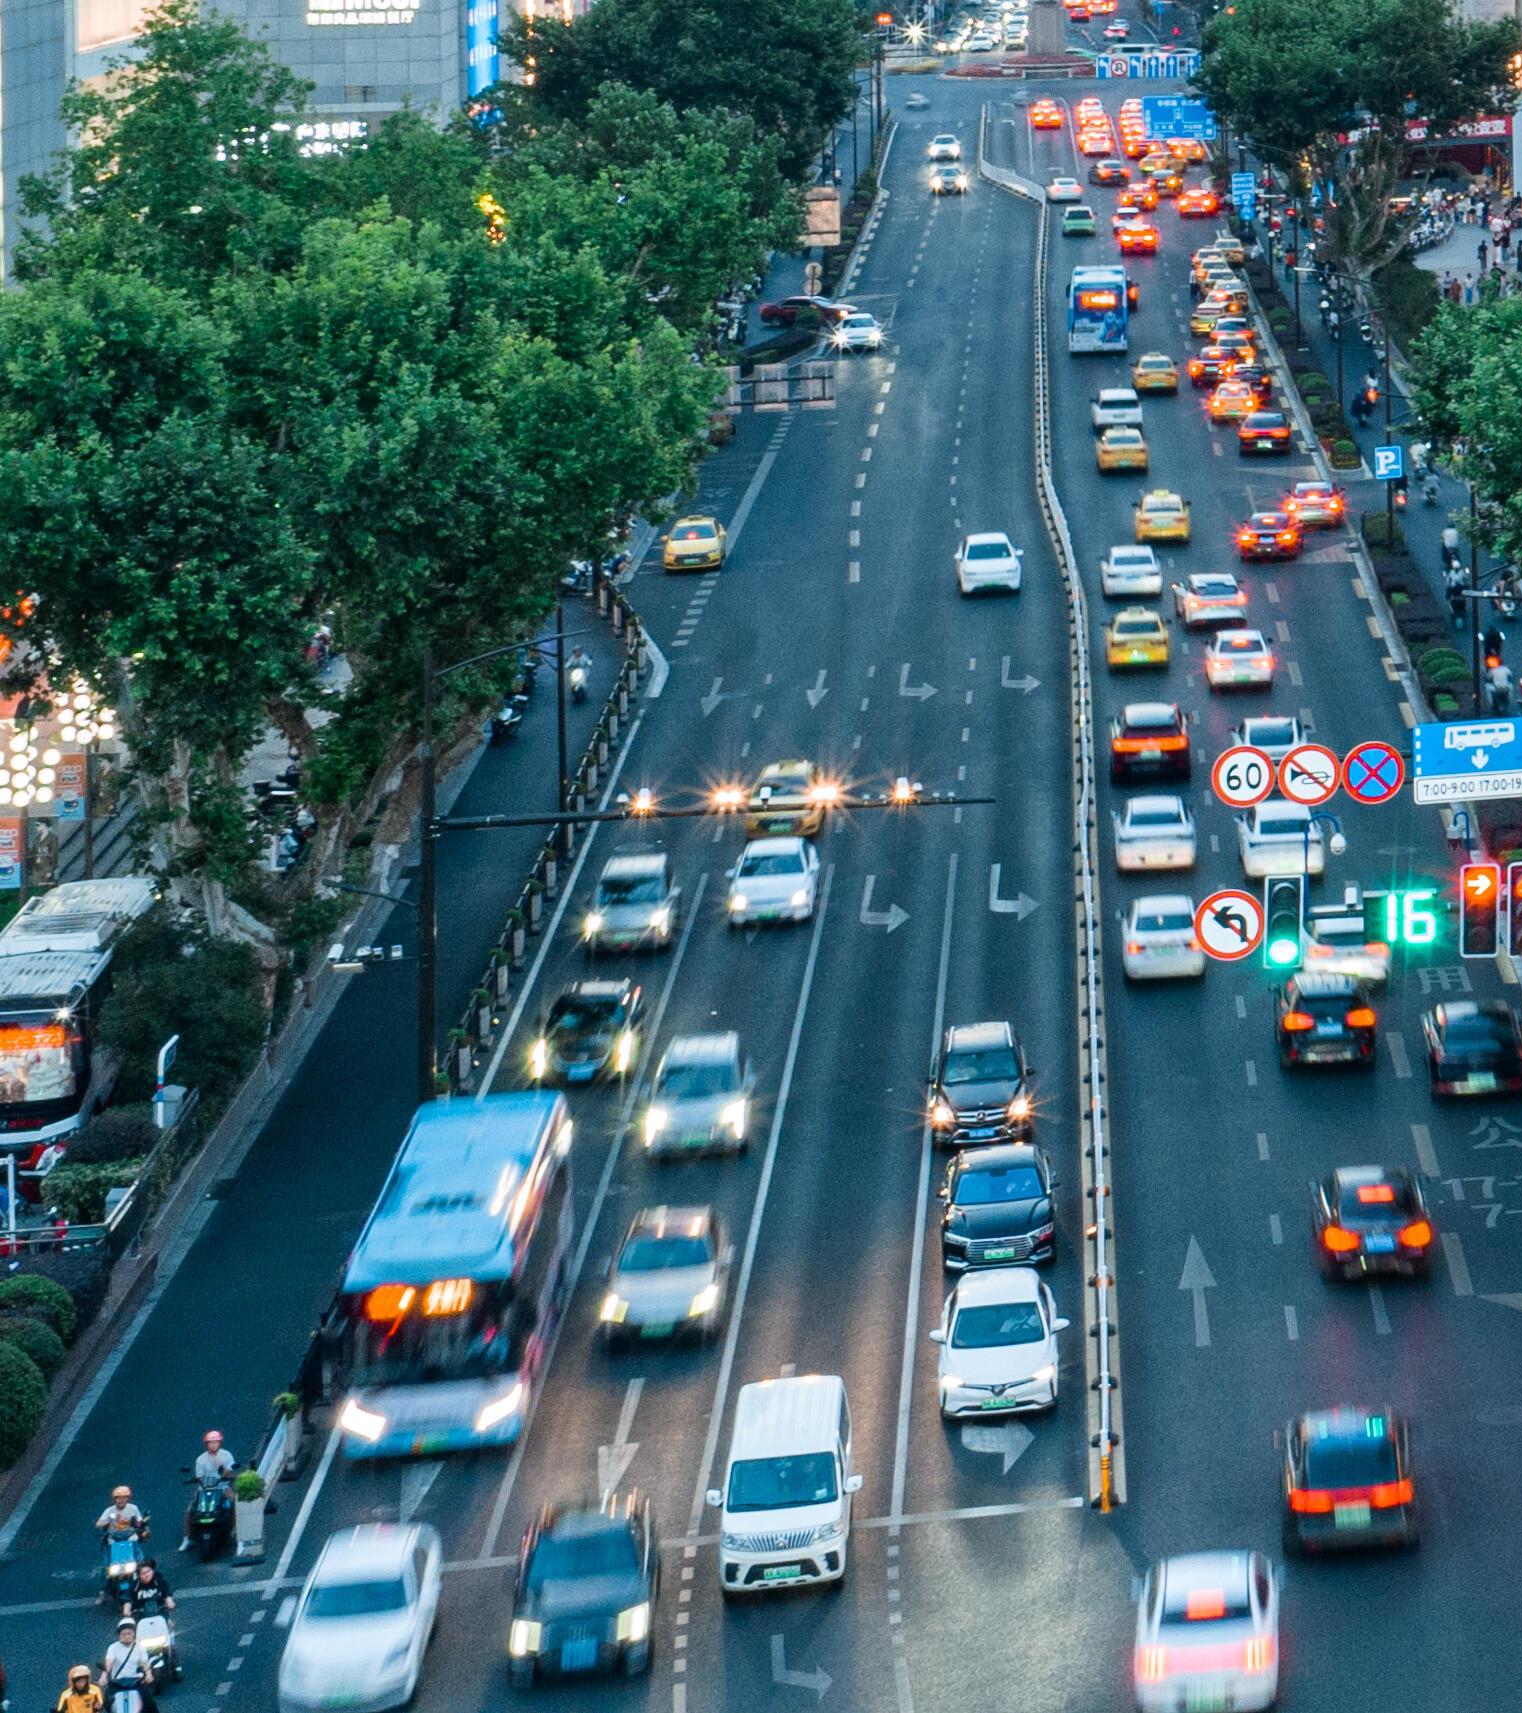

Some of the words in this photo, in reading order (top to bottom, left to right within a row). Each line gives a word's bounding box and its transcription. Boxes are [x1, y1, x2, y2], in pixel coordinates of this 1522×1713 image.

[1225, 762, 1263, 791] 60
[1423, 780, 1476, 797] 7:00-9:00
[1386, 890, 1438, 944] 16
